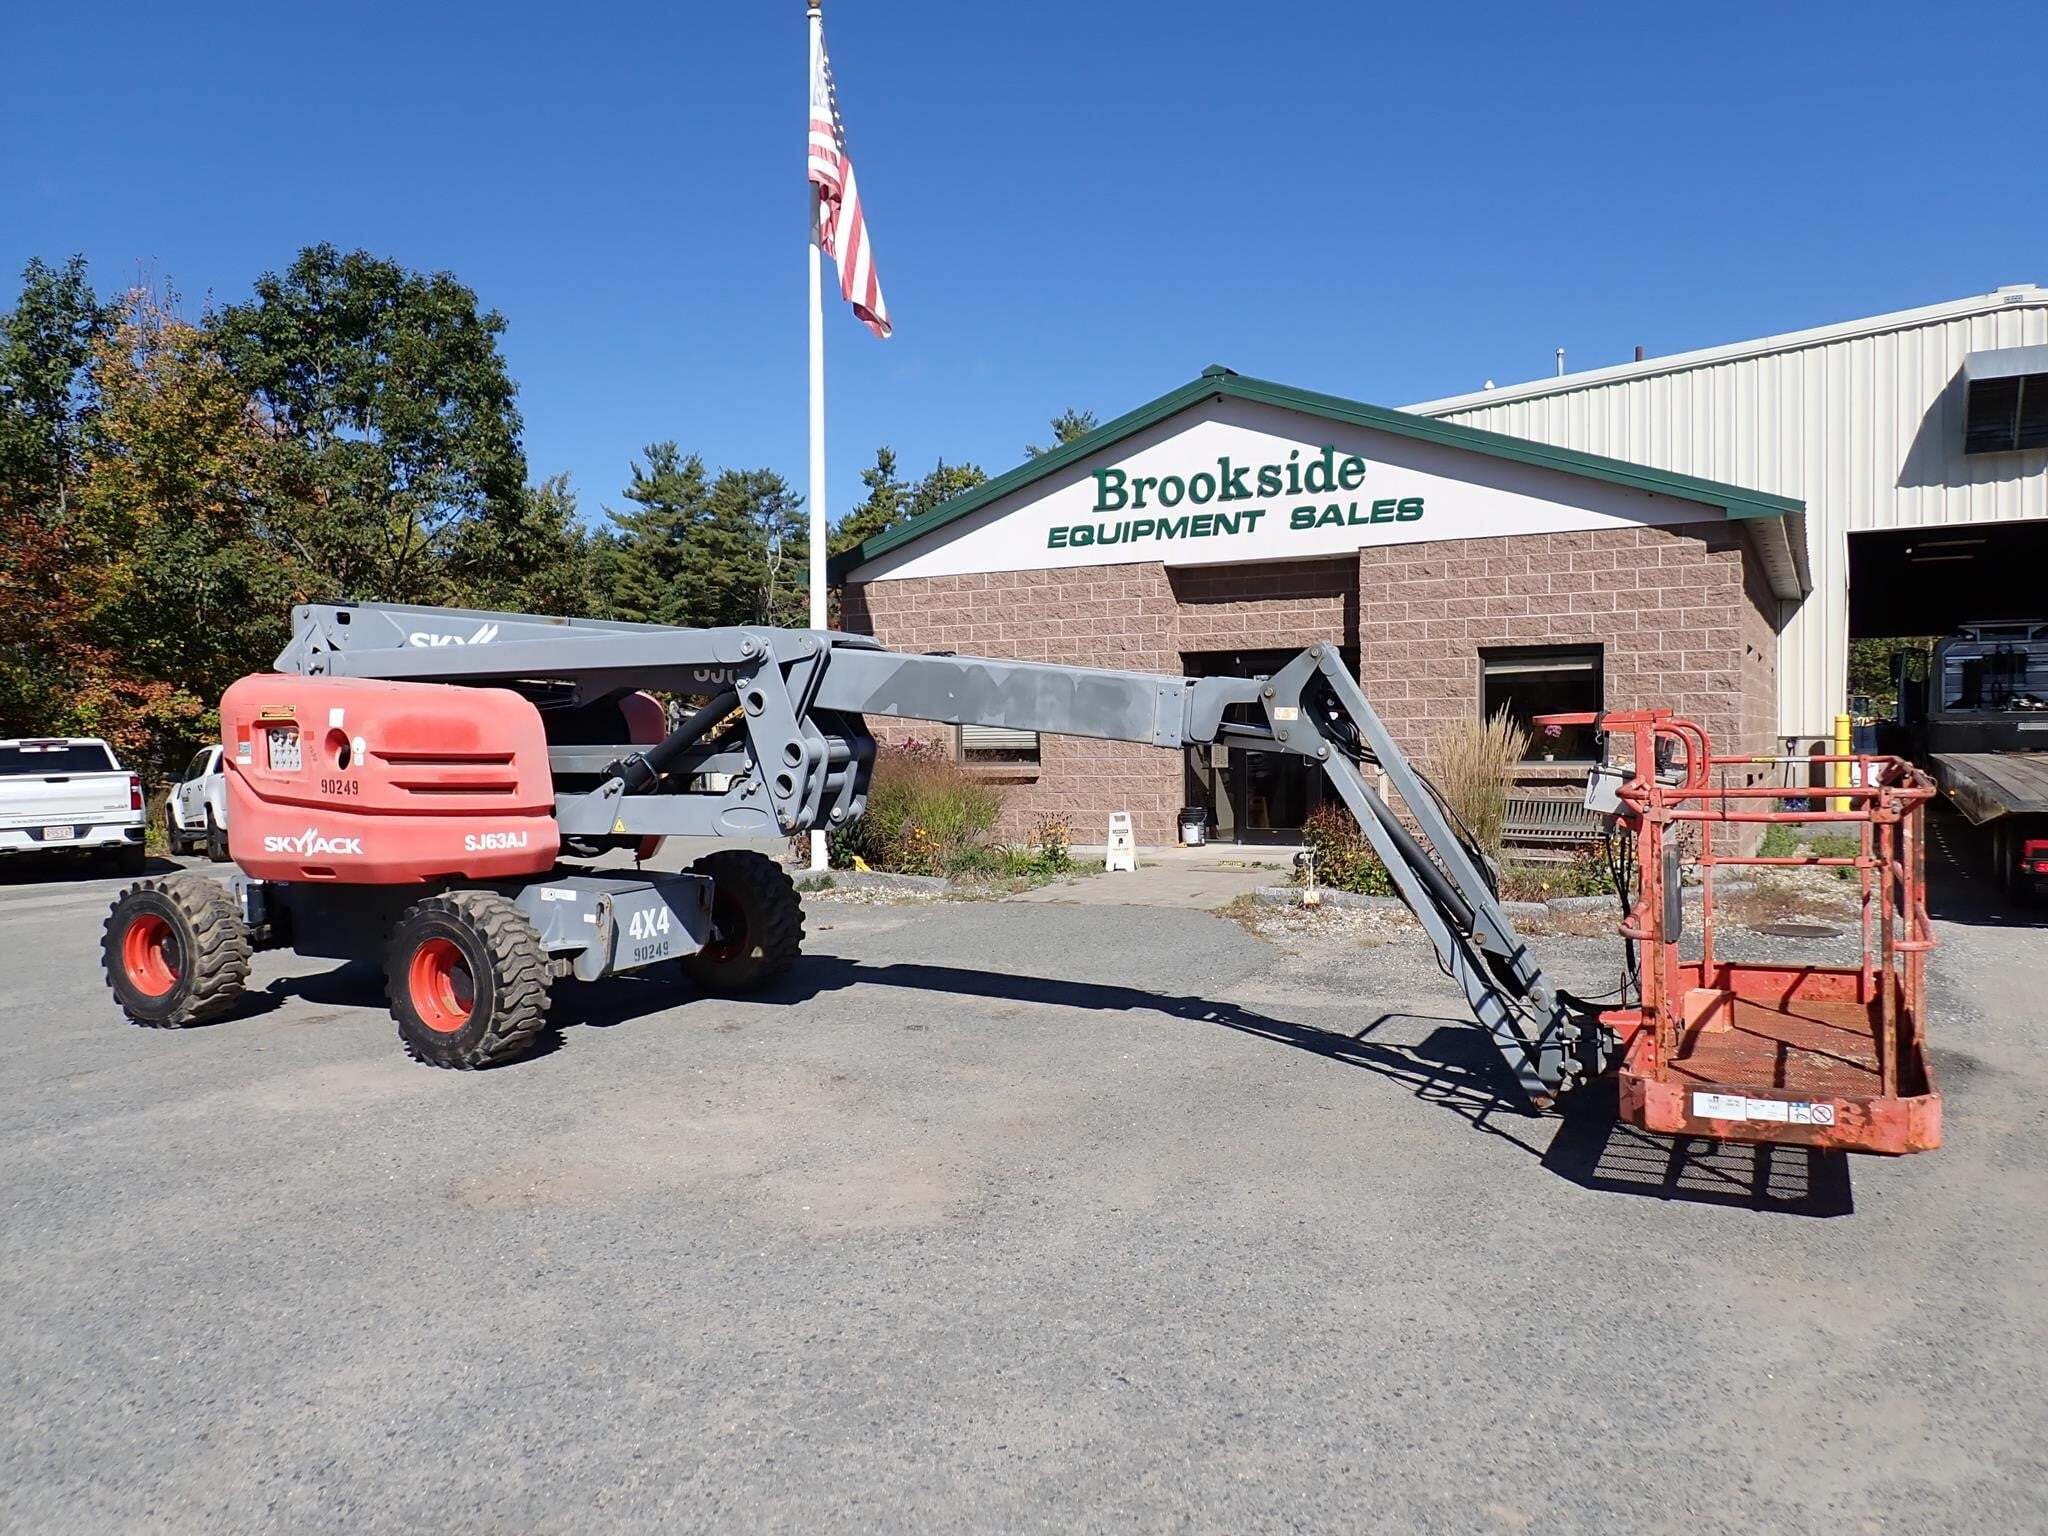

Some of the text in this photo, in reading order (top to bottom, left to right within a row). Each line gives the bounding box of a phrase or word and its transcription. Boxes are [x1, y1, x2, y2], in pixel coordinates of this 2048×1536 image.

[1092, 447, 1366, 513] Brookside
[1048, 497, 1425, 549] EQUIPMENT SALES
[321, 779, 359, 795] 90249
[264, 828, 528, 857] SKYJACK SJ63AJ
[629, 906, 670, 940] 4X4
[634, 941, 670, 962] 90249
